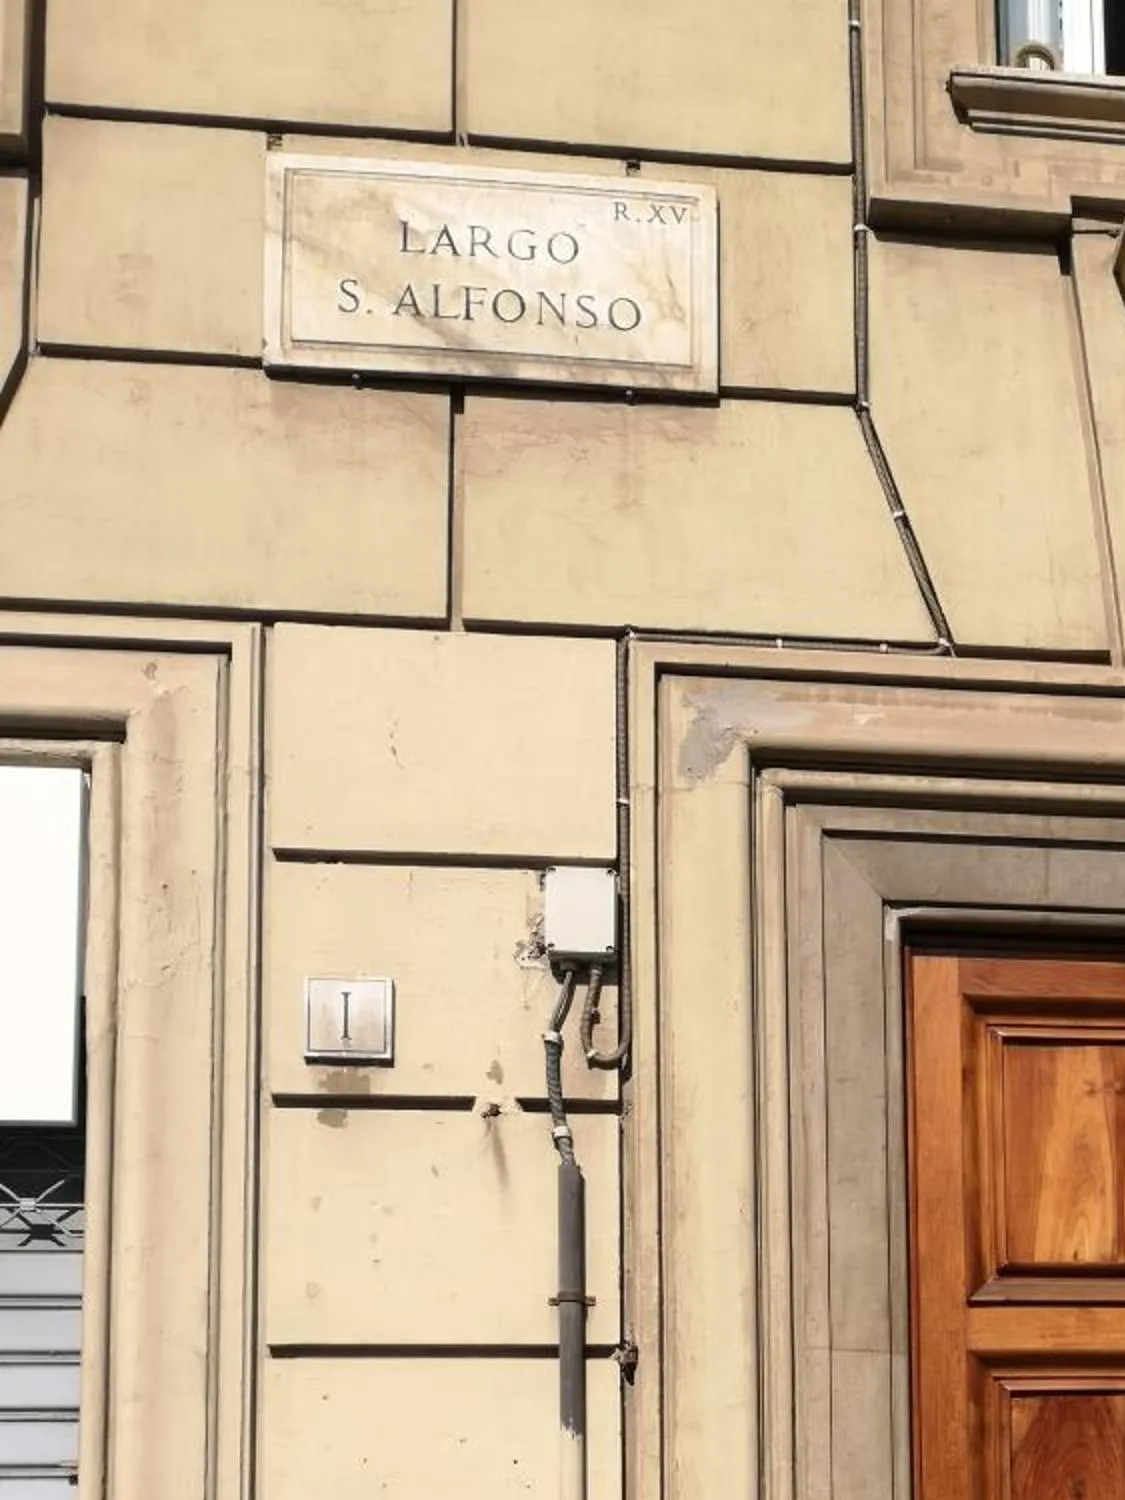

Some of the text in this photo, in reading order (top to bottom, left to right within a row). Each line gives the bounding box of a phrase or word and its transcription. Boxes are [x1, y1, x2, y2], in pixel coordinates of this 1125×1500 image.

[399, 219, 579, 264] LARGO
[337, 278, 642, 332] S. ALFONSO
